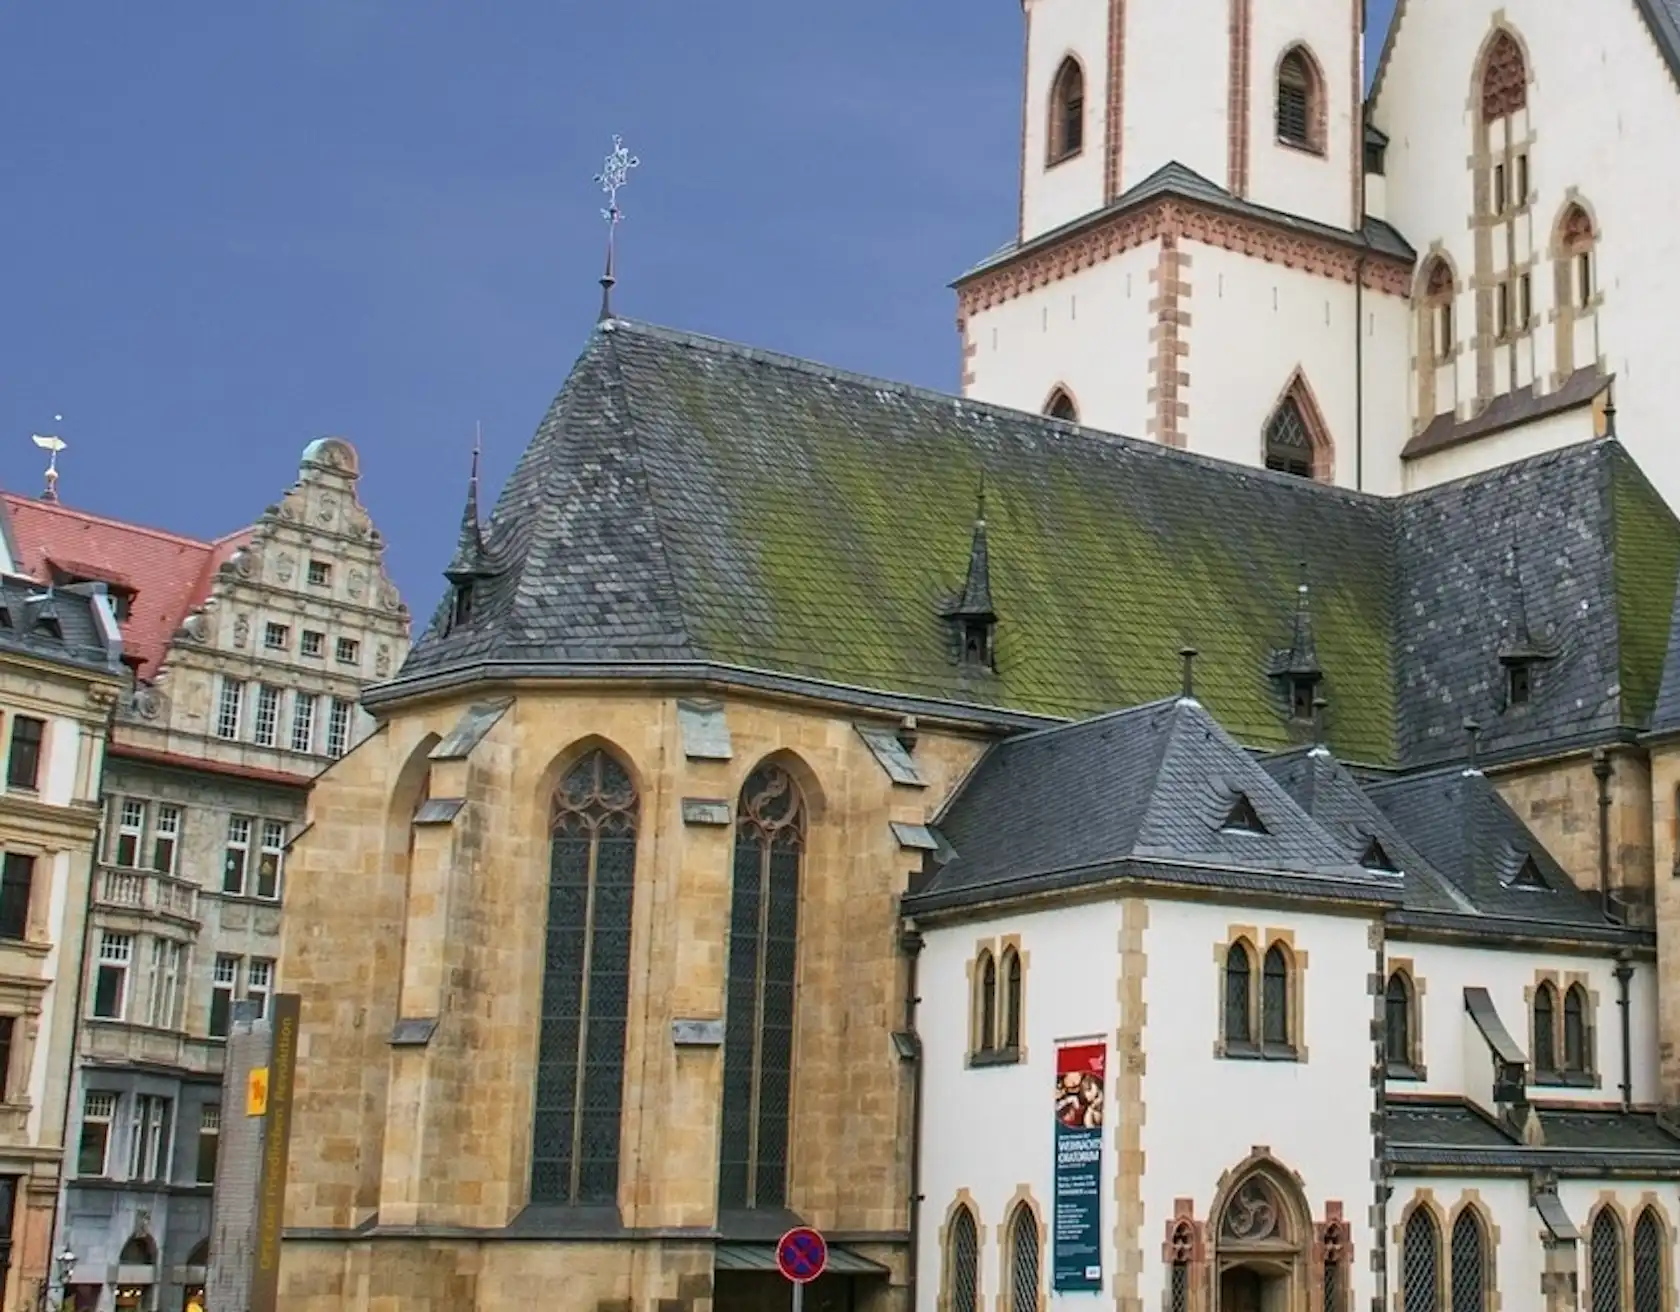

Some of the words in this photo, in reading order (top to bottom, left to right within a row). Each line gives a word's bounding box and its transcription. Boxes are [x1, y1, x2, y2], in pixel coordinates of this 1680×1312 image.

[274, 1016, 292, 1101] Revolution
[266, 1106, 283, 1196] Friedlichen
[264, 1203, 277, 1230] der
